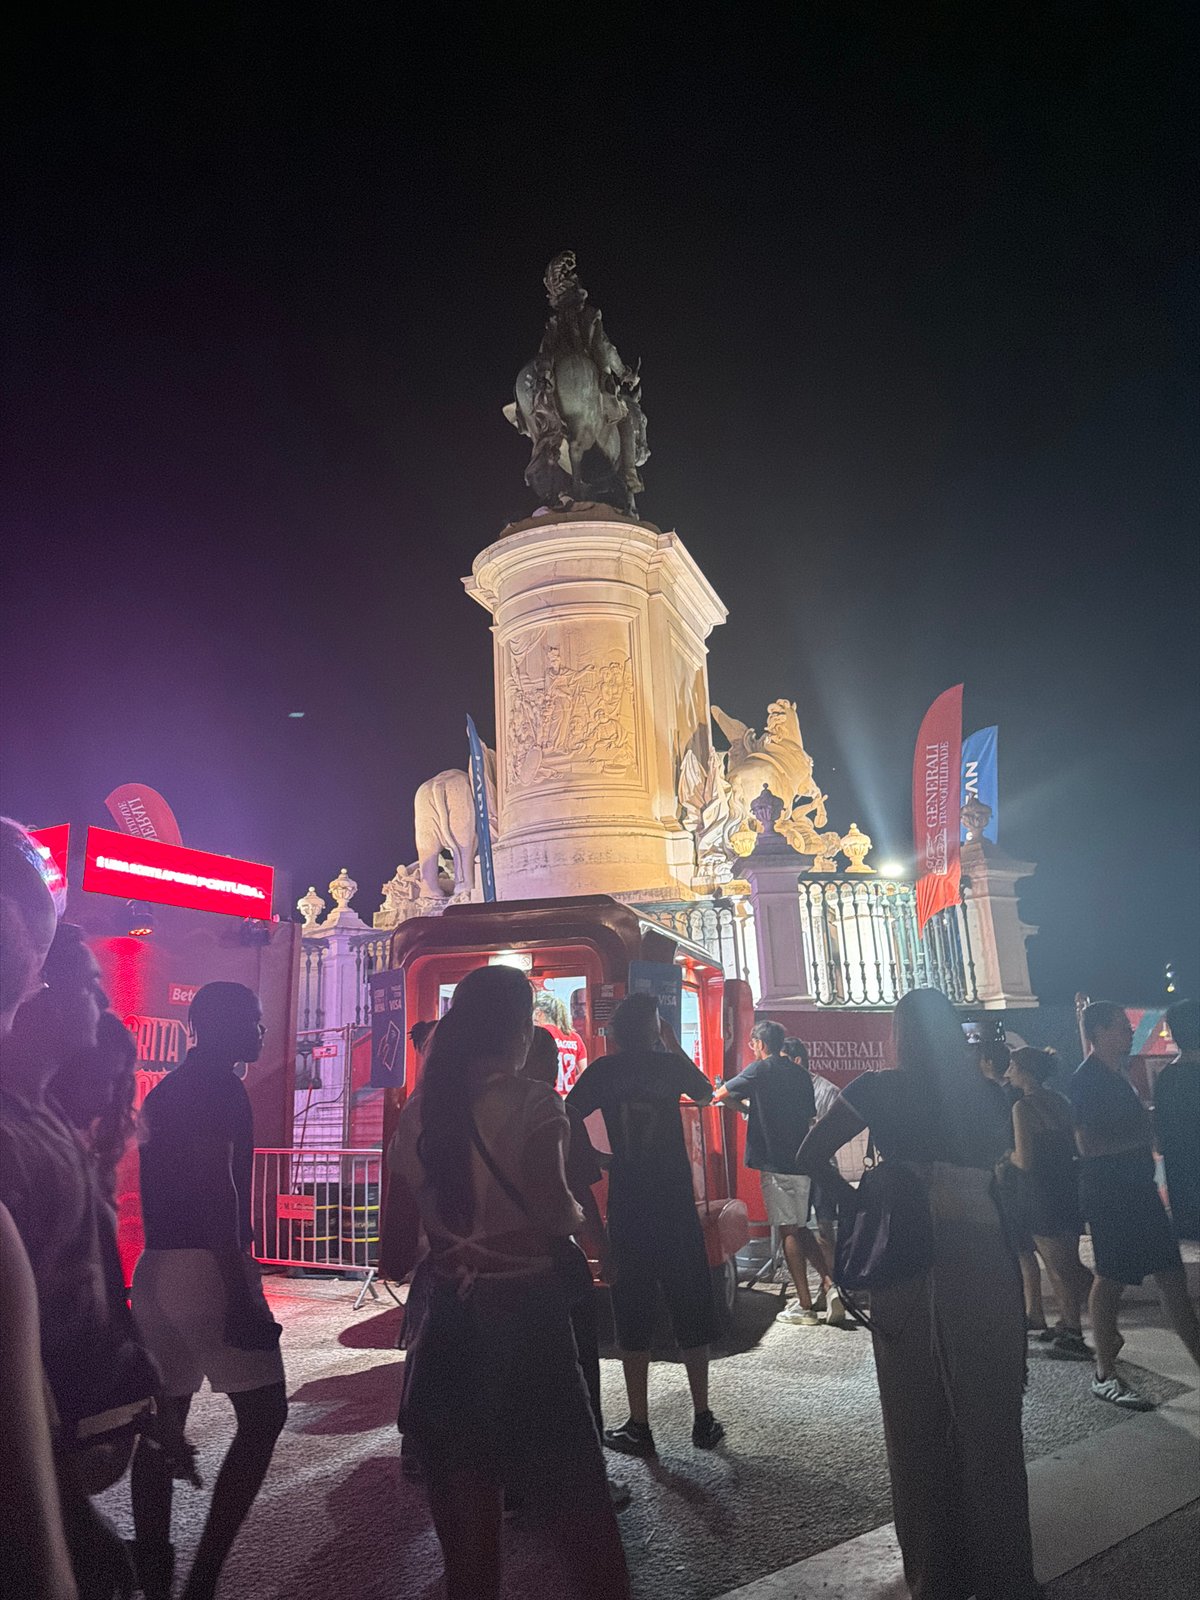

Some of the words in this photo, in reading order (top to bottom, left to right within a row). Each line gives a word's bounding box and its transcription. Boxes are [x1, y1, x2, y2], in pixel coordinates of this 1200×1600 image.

[925, 743, 940, 828] GENERALI
[939, 741, 950, 825] TRANQUILIDADE
[658, 994, 677, 1006] VISA
